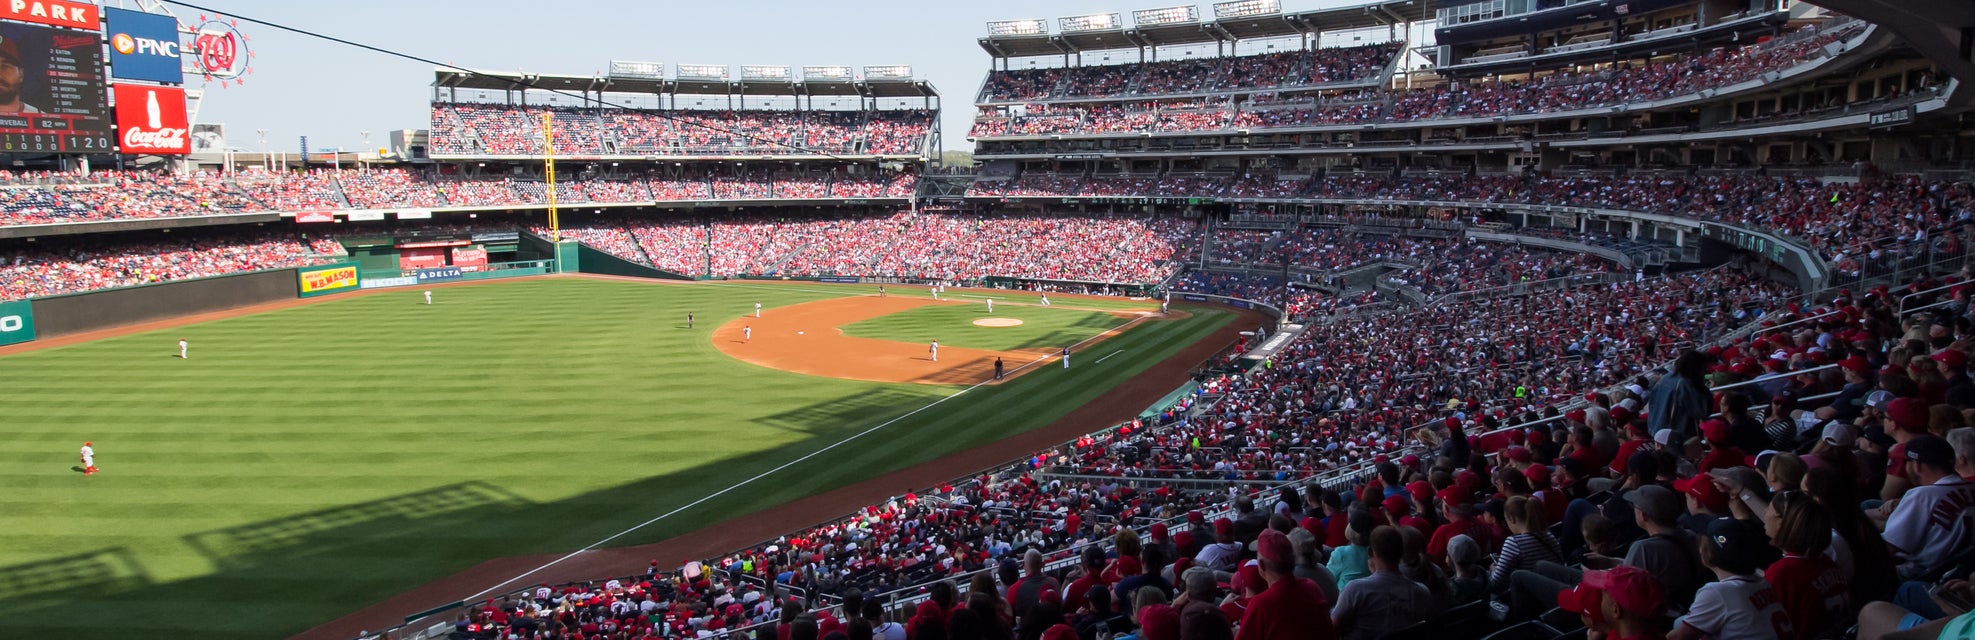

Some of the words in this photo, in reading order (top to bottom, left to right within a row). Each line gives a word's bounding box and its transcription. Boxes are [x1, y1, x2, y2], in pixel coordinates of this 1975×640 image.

[11, 0, 87, 23] PARK
[135, 37, 179, 58] PNC
[71, 137, 77, 148] 1
[84, 138, 93, 148] 2
[99, 138, 108, 149] 0
[125, 127, 186, 149] Coca-Cola
[429, 270, 460, 279] DELTA
